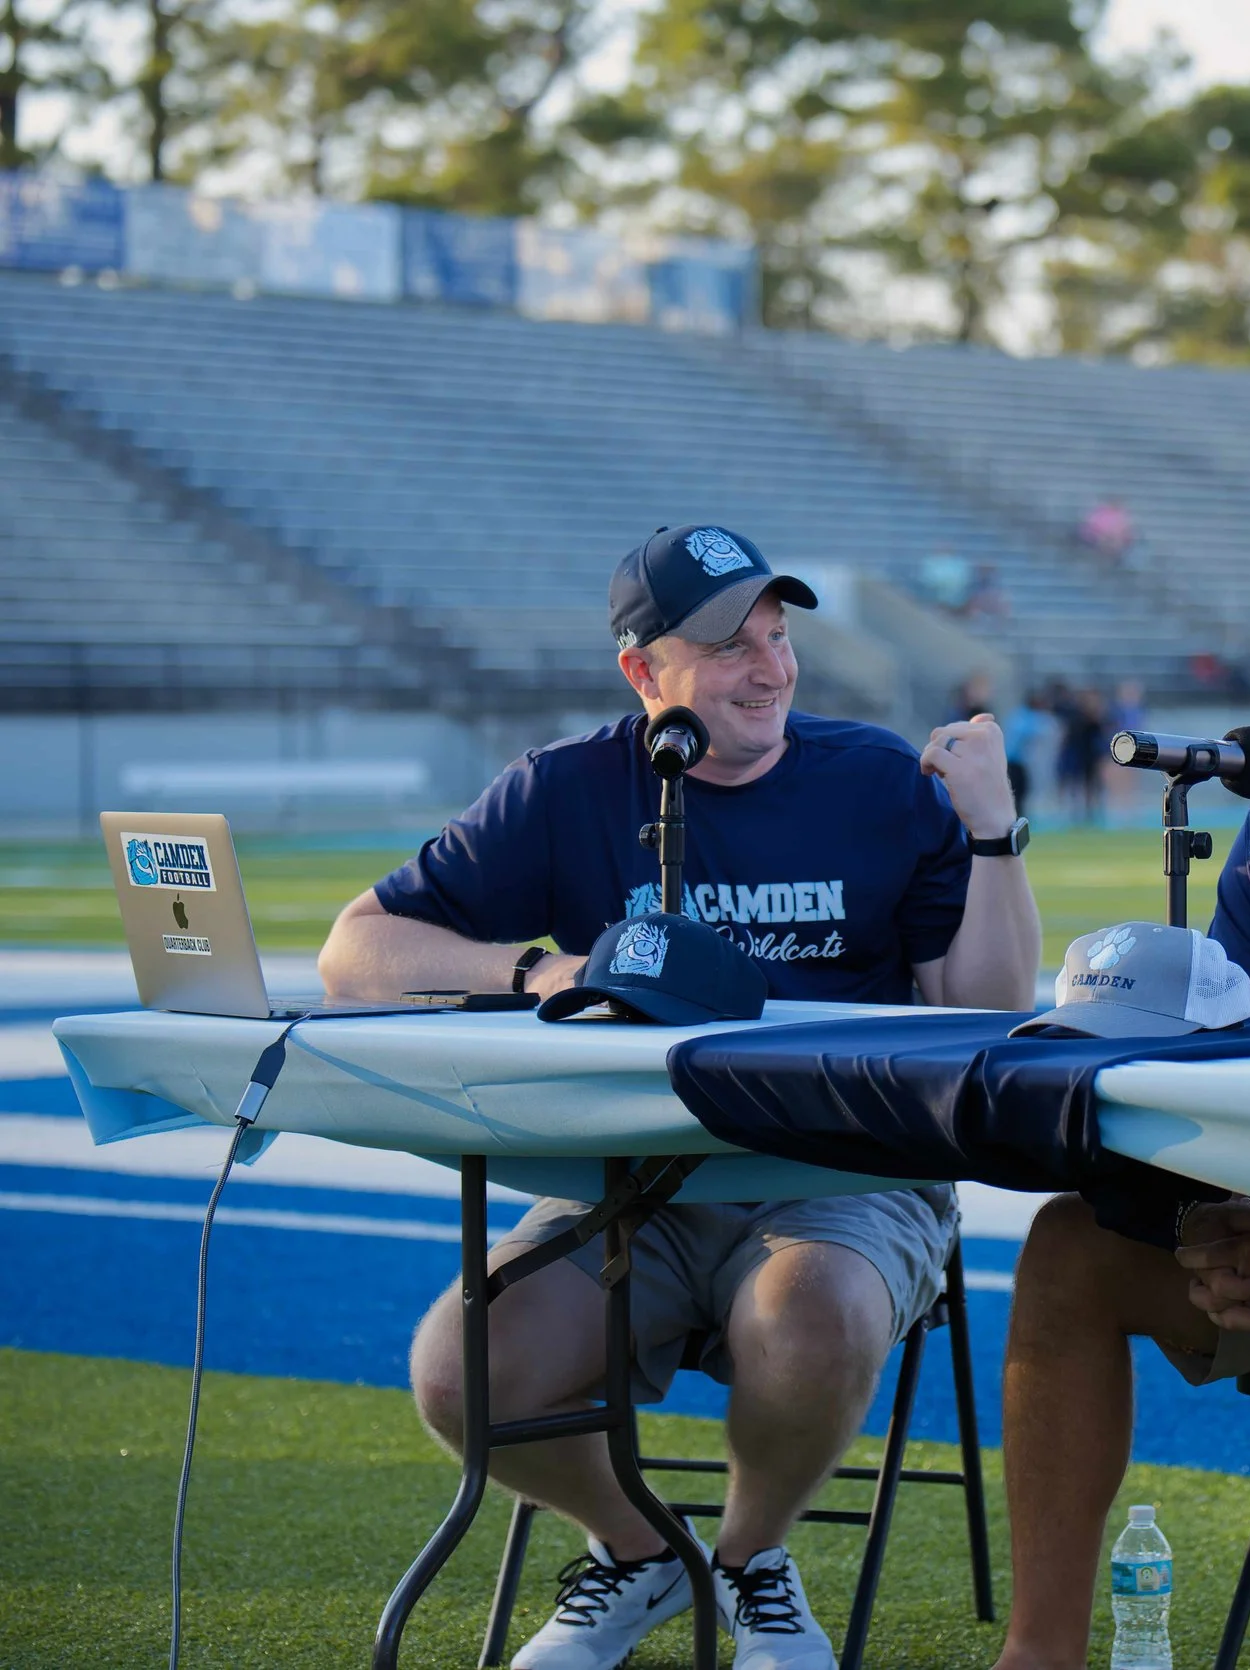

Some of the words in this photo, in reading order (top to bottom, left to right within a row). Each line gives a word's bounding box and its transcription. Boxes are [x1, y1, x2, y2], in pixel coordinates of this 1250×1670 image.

[153, 842, 208, 870] CAMDEN
[161, 871, 208, 886] FOOTBALL
[694, 880, 846, 923] CAMDEN
[196, 938, 210, 952] CLUB
[1071, 973, 1136, 990] CAMDEN
